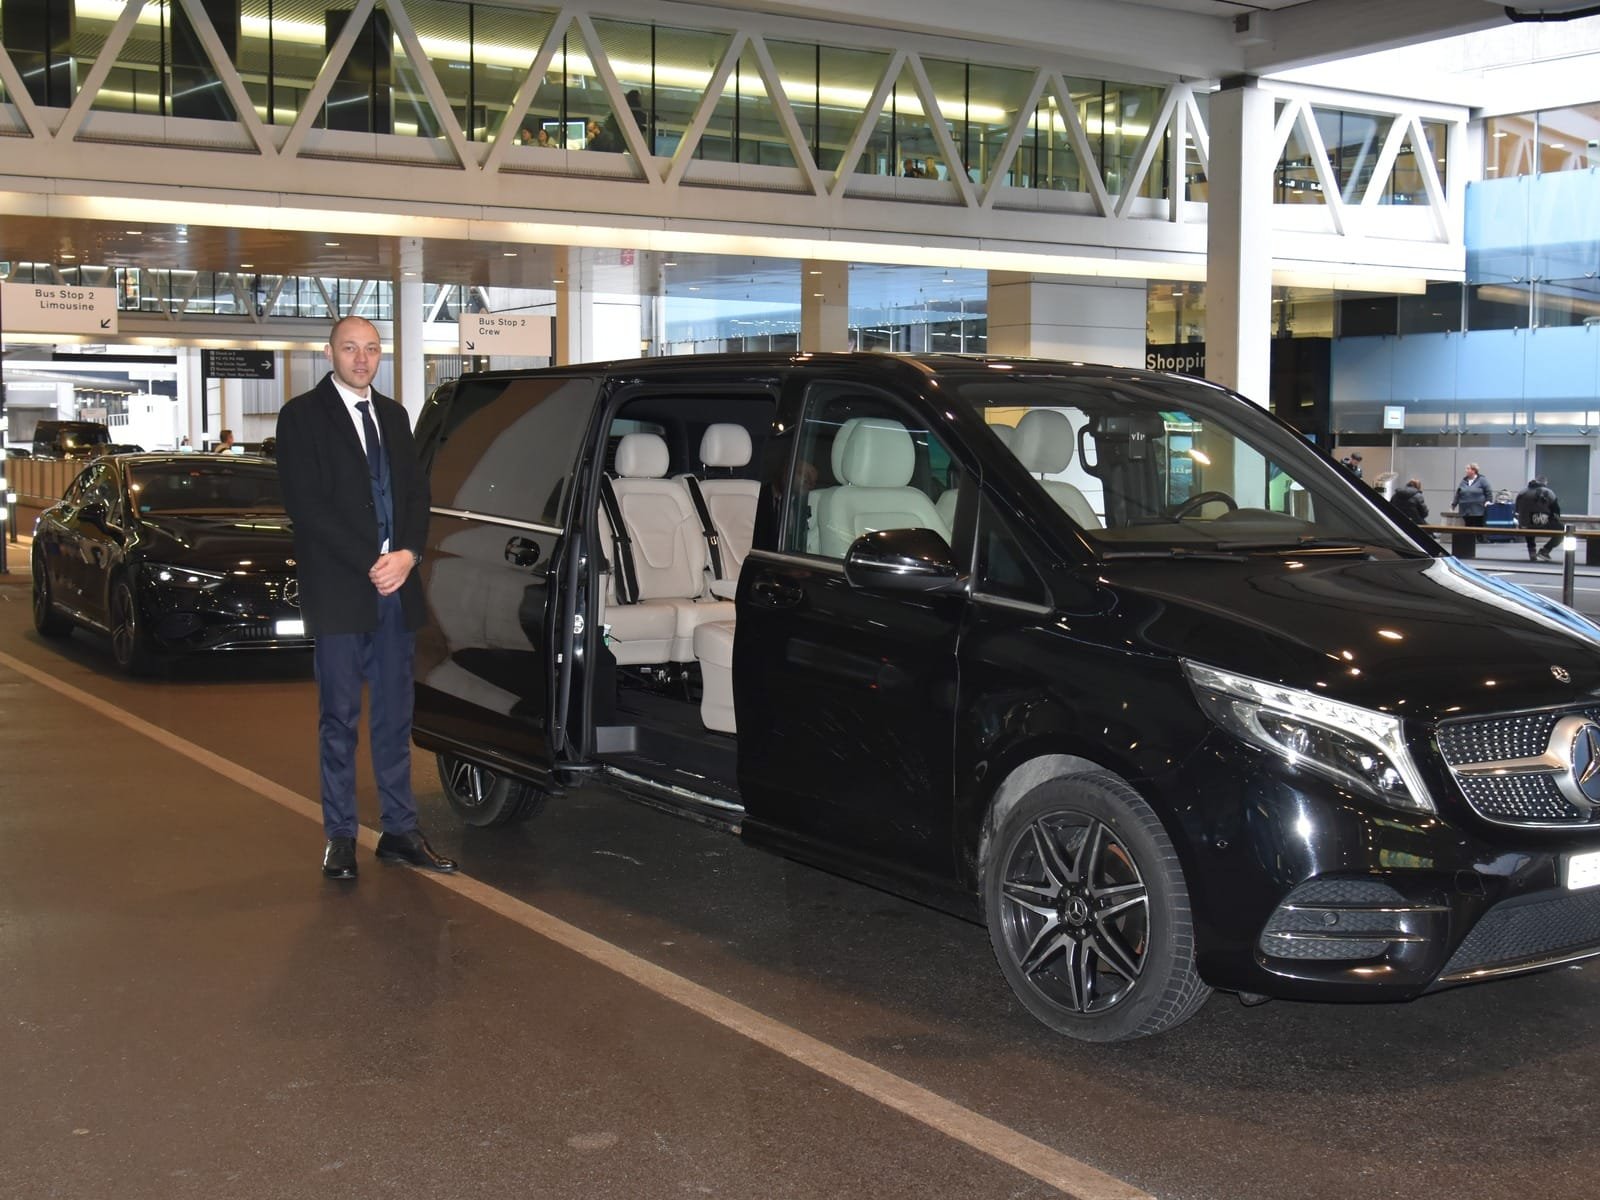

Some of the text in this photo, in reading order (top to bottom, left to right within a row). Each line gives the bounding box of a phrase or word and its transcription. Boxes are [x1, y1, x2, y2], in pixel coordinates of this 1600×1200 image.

[35, 289, 95, 300] Bus Stop 2
[40, 301, 95, 311] Limousine
[498, 318, 518, 326] Stop
[1146, 352, 1206, 372] Shoppin
